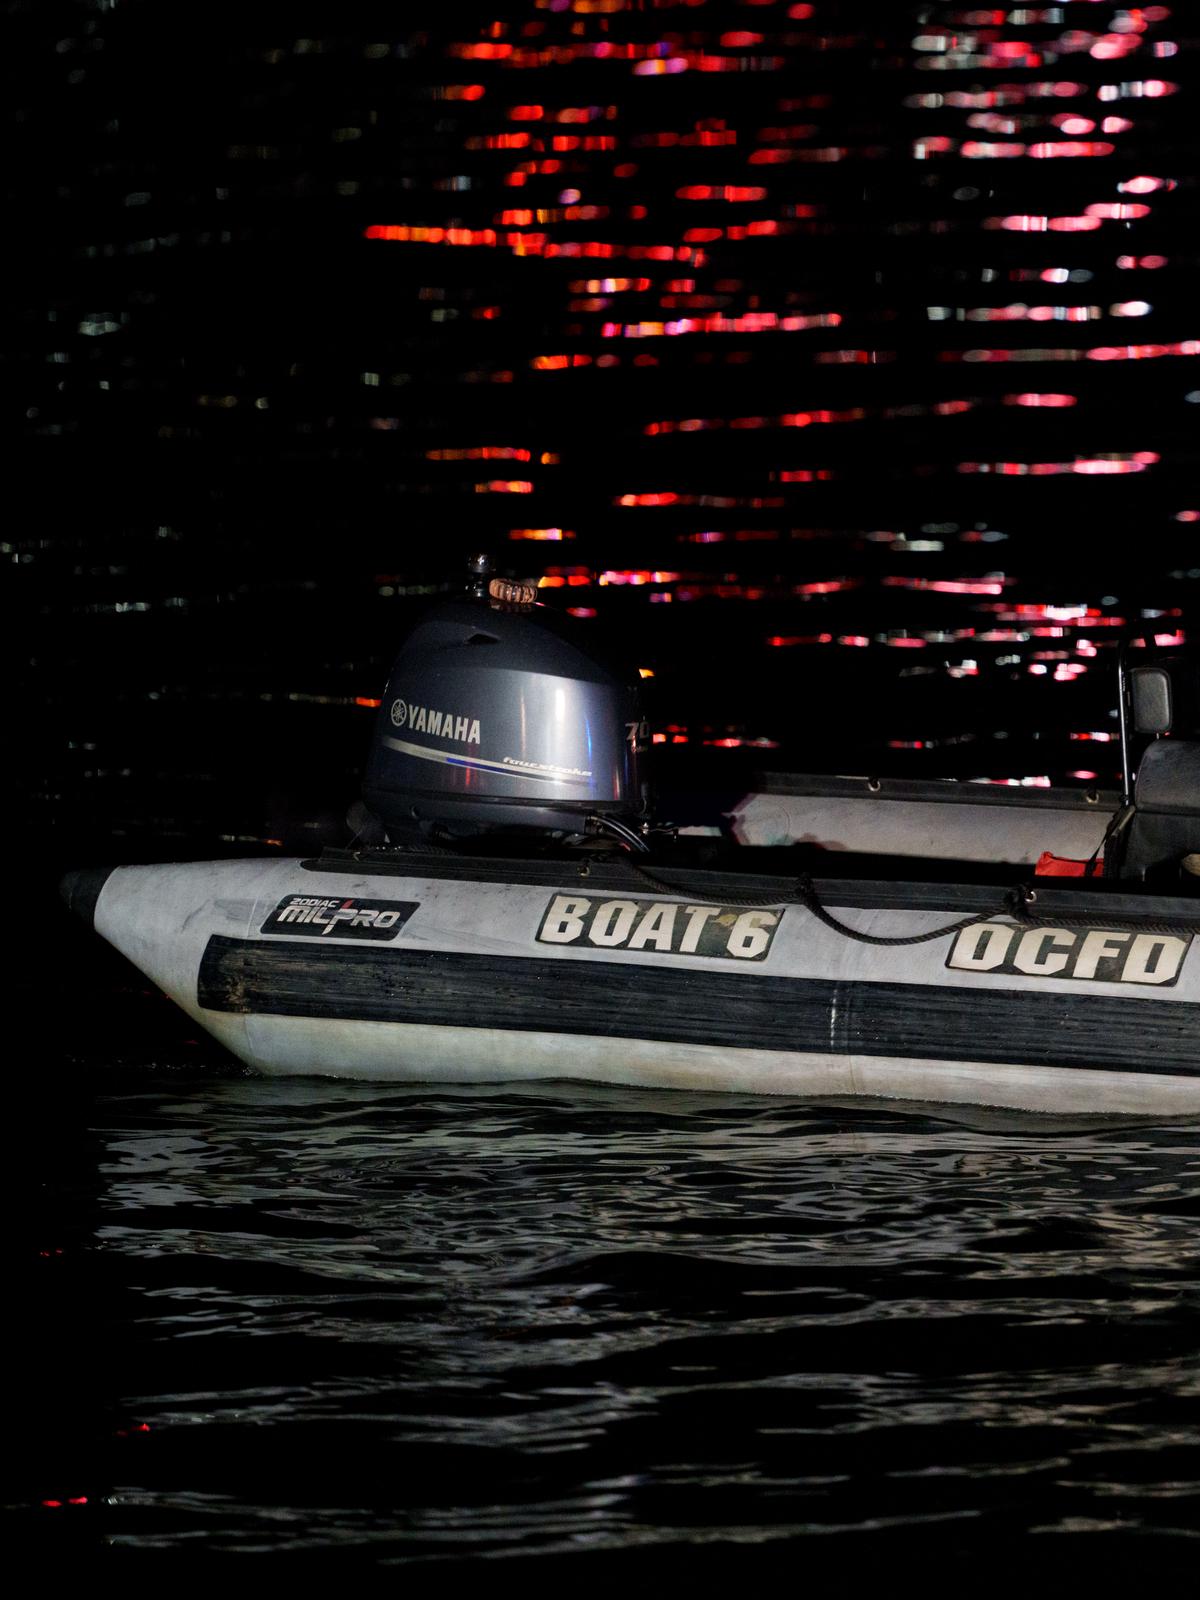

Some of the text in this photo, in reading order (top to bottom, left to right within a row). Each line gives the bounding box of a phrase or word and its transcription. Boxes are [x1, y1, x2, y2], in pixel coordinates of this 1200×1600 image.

[409, 704, 480, 744] YAMAHA
[289, 897, 340, 908] ZODIAC
[539, 895, 779, 958] BOAT 6
[949, 922, 1188, 984] OCFD
